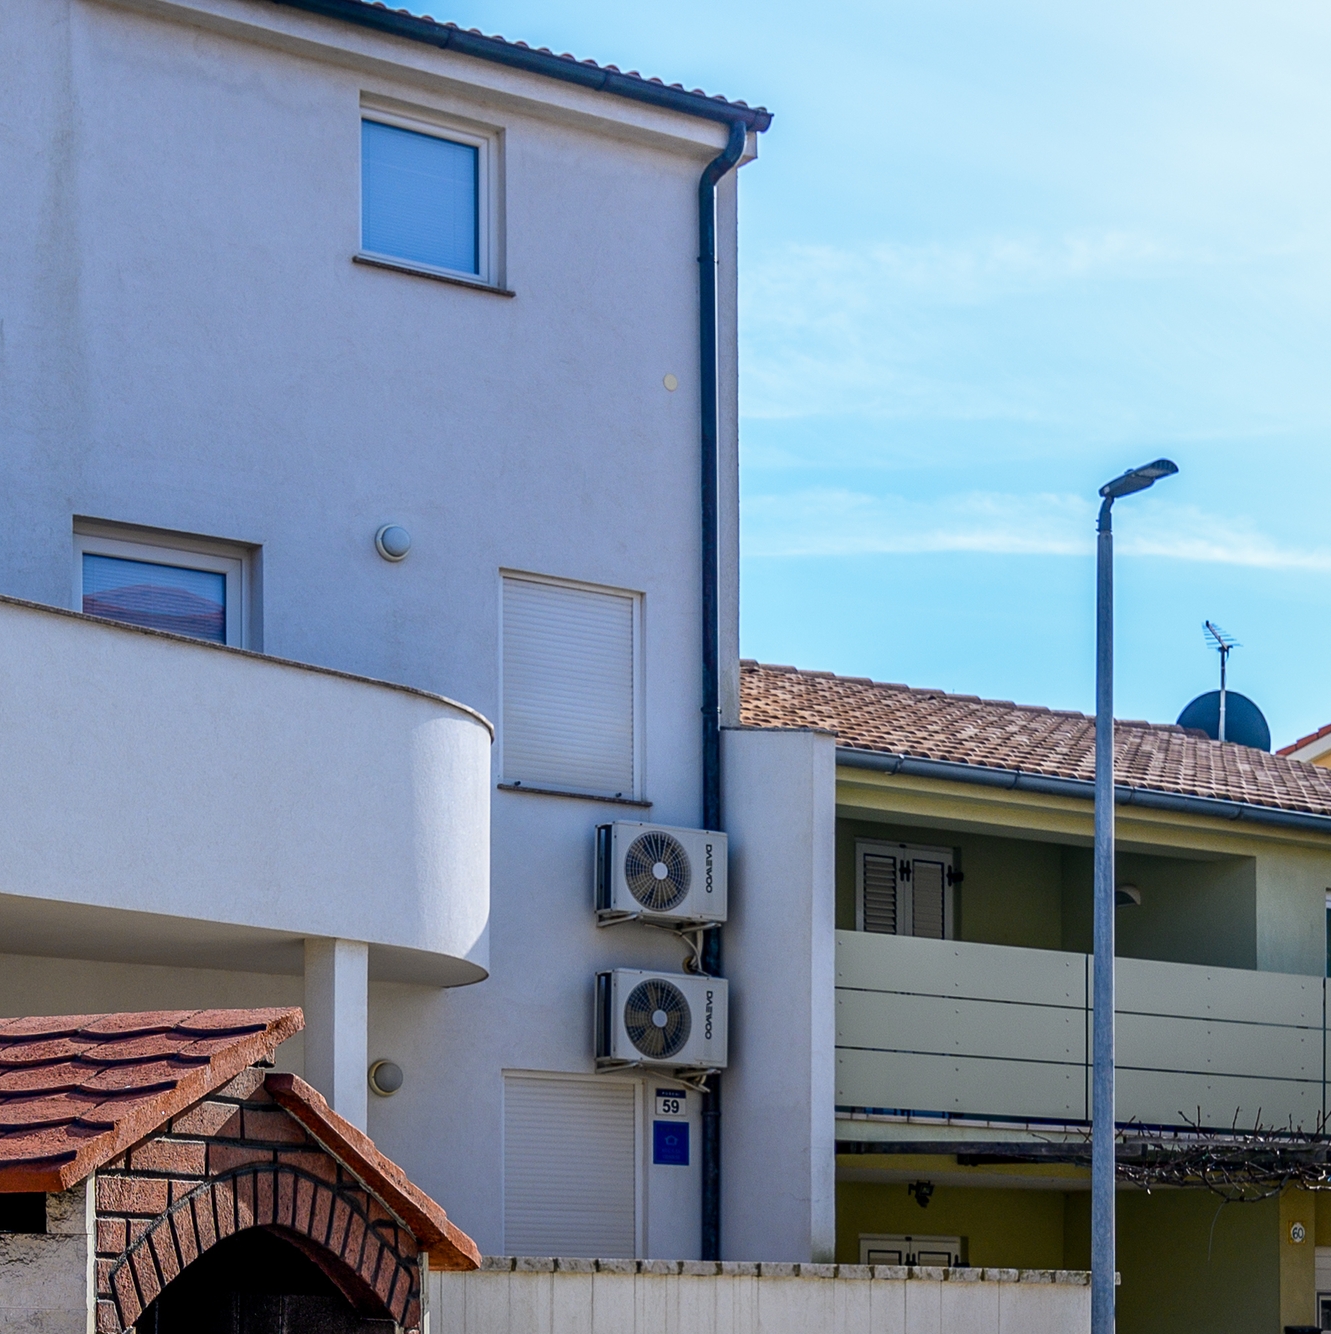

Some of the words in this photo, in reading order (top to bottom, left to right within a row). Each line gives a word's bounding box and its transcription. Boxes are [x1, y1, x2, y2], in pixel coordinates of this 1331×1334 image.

[705, 844, 713, 893] DAEWOO
[705, 990, 713, 1040] DAEWOO
[662, 1099, 680, 1113] 59
[1292, 1226, 1304, 1239] 60
